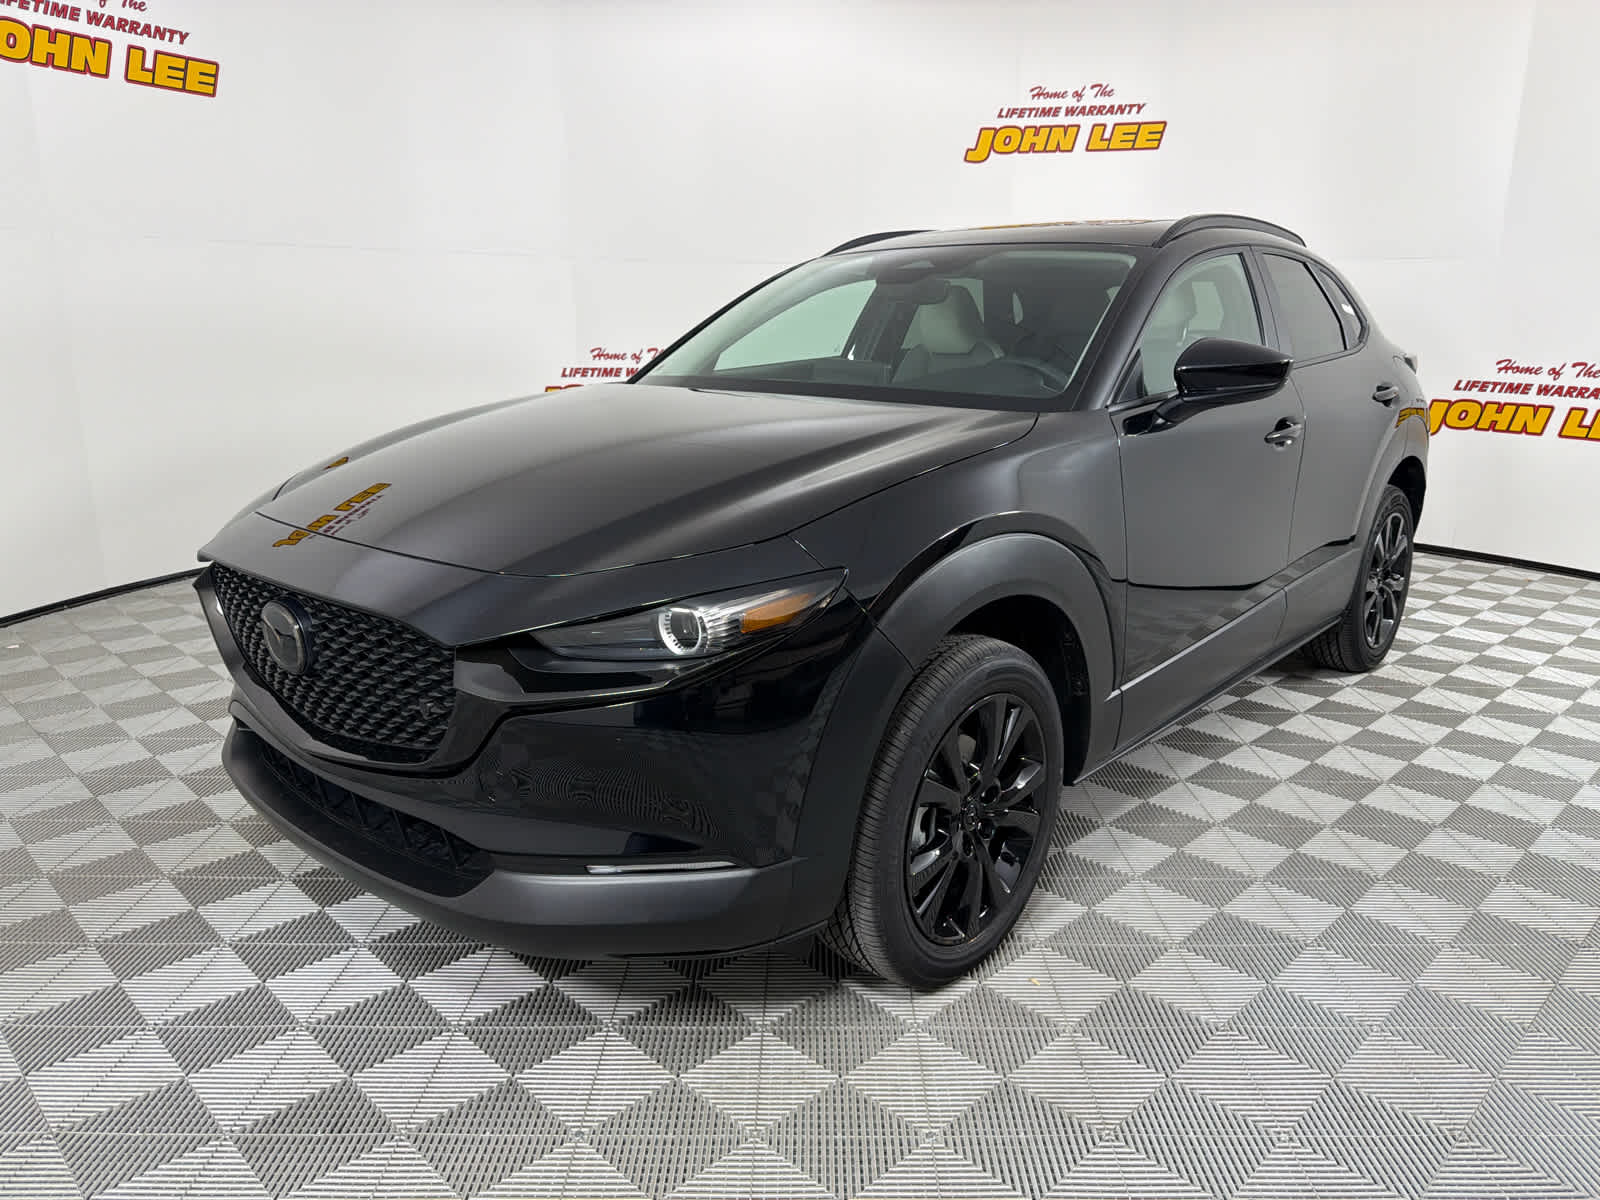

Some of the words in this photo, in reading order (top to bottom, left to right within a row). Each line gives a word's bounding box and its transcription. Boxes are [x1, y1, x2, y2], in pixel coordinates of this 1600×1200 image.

[86, 9, 190, 45] WARRANTY
[124, 44, 220, 98] LEE
[1029, 85, 1069, 101] Home
[1071, 84, 1085, 102] of
[1090, 83, 1115, 99] The
[997, 106, 1061, 119] LIFETIME
[1064, 102, 1147, 117] WARRANTY
[964, 123, 1081, 163] JOHN
[1085, 121, 1167, 153] LEE
[590, 346, 628, 361] Home
[630, 347, 643, 364] of
[560, 367, 622, 378] LIFETIME
[1495, 358, 1543, 376] Home
[1547, 362, 1566, 380] of
[1453, 379, 1534, 395] LIFETIME
[1536, 383, 1600, 400] WARRA
[1428, 398, 1555, 437] JOHN
